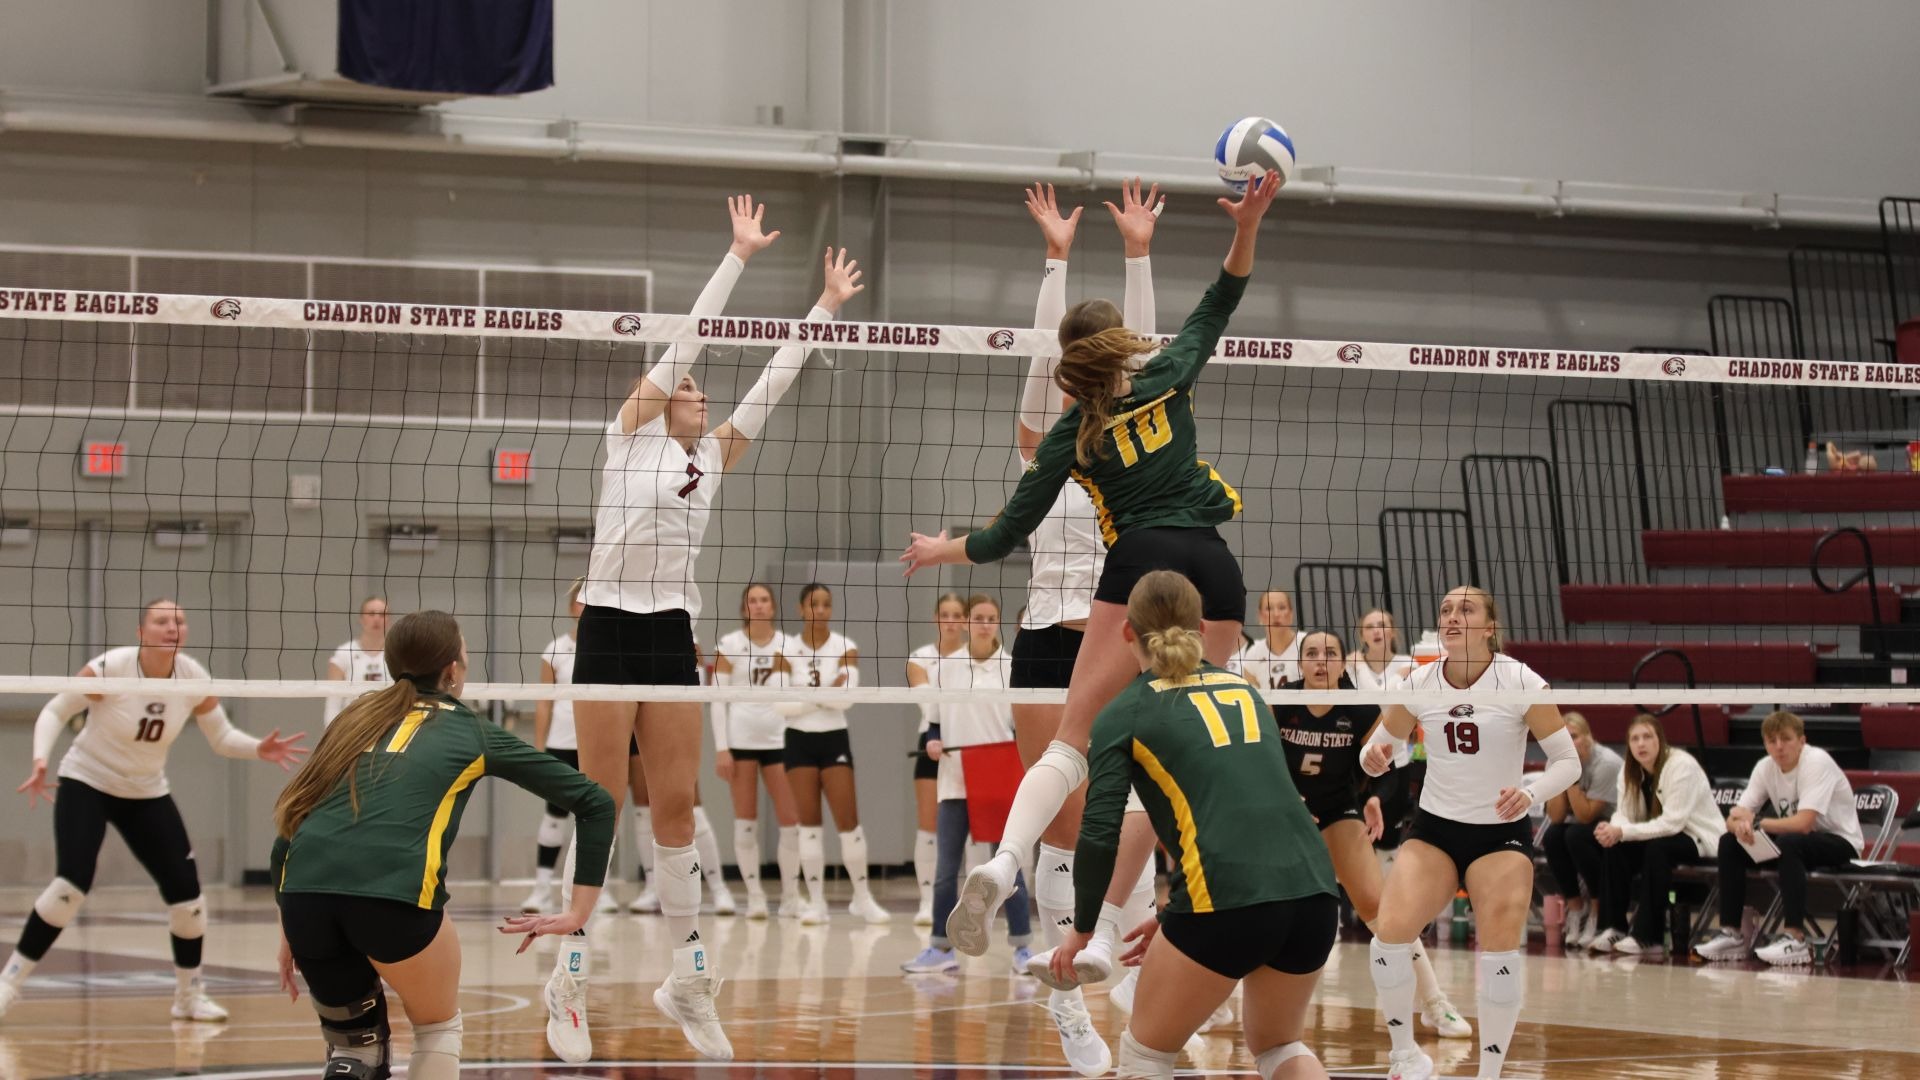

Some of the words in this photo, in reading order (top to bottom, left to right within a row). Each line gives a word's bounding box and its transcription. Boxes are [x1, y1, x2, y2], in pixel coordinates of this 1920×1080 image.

[0, 290, 67, 312] STATE
[74, 293, 159, 316] EAGLES
[303, 302, 402, 325] CHADRON
[410, 306, 477, 328] STATE
[484, 309, 563, 331] EAGLES
[698, 318, 790, 340] CHADRON
[798, 323, 860, 343] STATE
[867, 325, 940, 346] EAGLES
[1224, 339, 1293, 360] EAGLES
[1409, 346, 1490, 367] CHADRON
[1496, 350, 1550, 370] STATE
[1556, 352, 1621, 373] EAGLES
[1728, 360, 1804, 380] CHADRON
[1808, 362, 1859, 382] STATE
[1864, 364, 1920, 384] EAGLES
[1112, 402, 1174, 469] 10
[88, 443, 124, 474] EXIT
[498, 451, 531, 480] EXIT
[678, 462, 705, 499] 7
[752, 667, 772, 686] 17
[808, 670, 820, 687] 3
[134, 717, 165, 742] 10
[1187, 688, 1261, 748] 17
[1323, 732, 1354, 748] STATE
[1443, 721, 1480, 755] 19
[1300, 753, 1323, 776] 5
